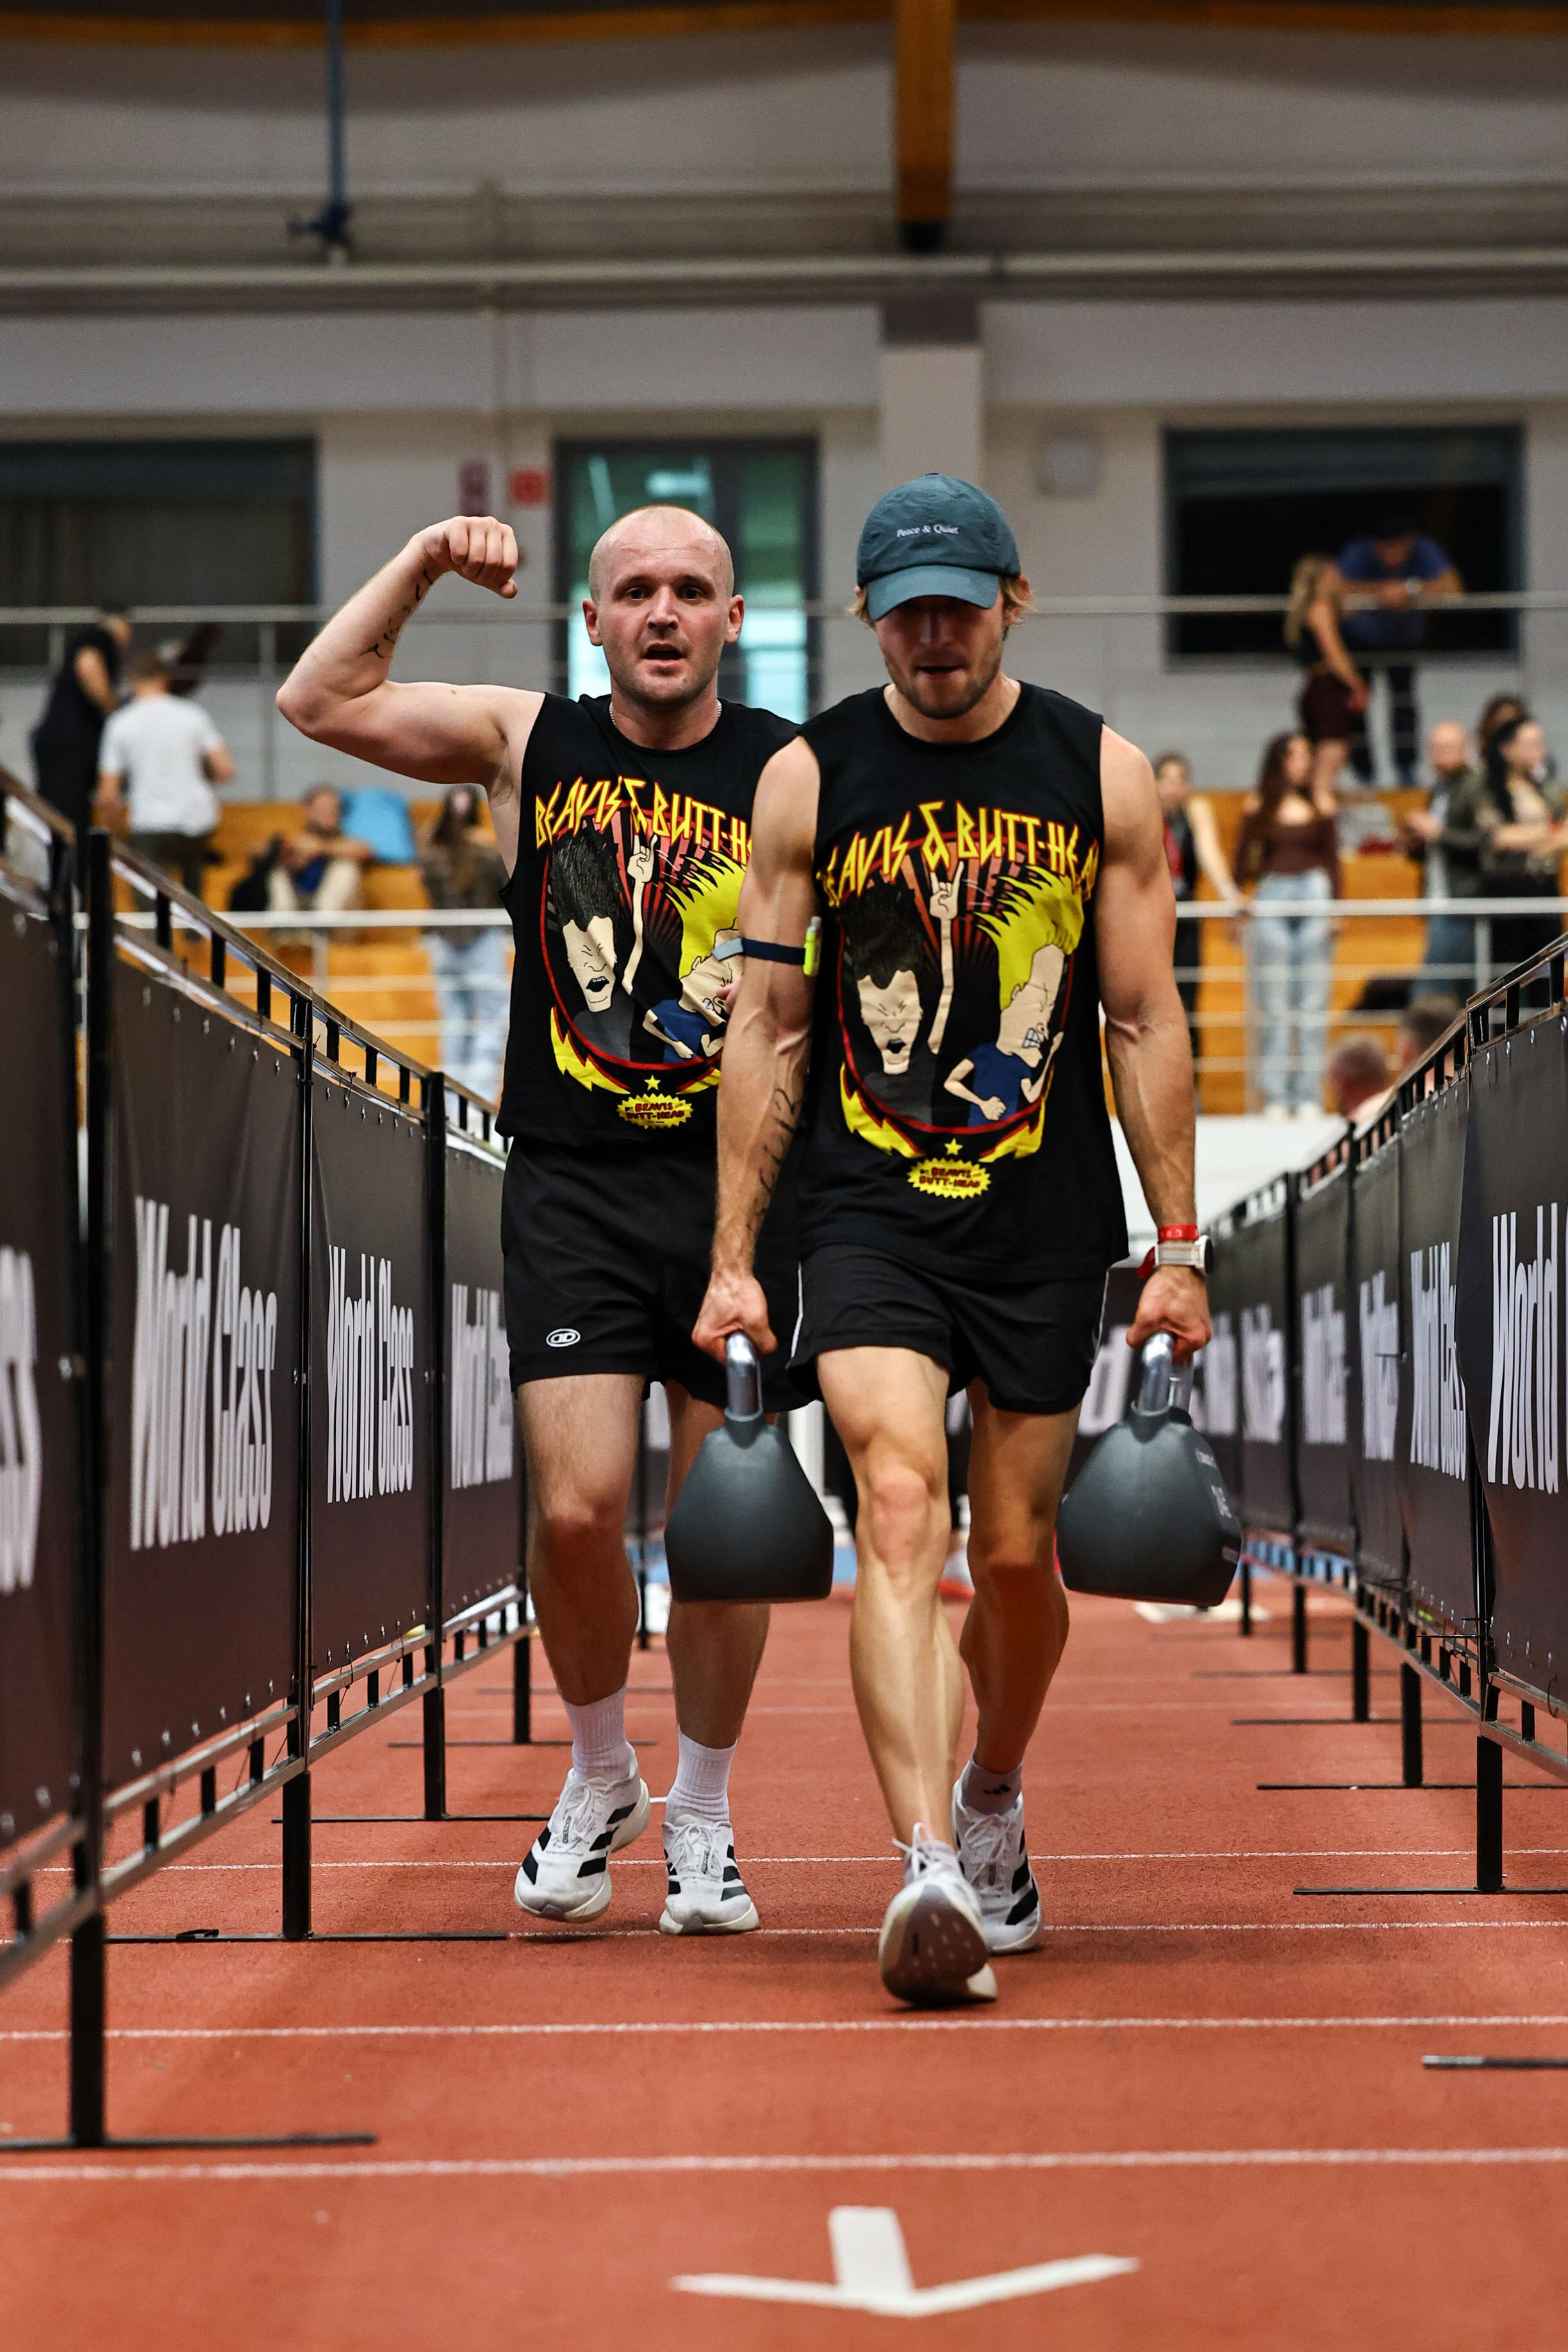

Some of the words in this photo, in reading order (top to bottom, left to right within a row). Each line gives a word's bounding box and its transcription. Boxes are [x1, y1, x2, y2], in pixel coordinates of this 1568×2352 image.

[921, 525, 931, 533] &
[535, 775, 622, 850] BEAVIS
[652, 781, 752, 866] BUTT-H
[816, 810, 911, 907] EAVIS
[956, 800, 1100, 902] BUTT-HEA
[635, 1102, 673, 1112] BEAVIS
[131, 1195, 212, 1552] World
[212, 1223, 277, 1537] Class
[327, 1243, 375, 1503] World
[378, 1257, 414, 1496] Class
[1488, 1202, 1558, 1495] World
